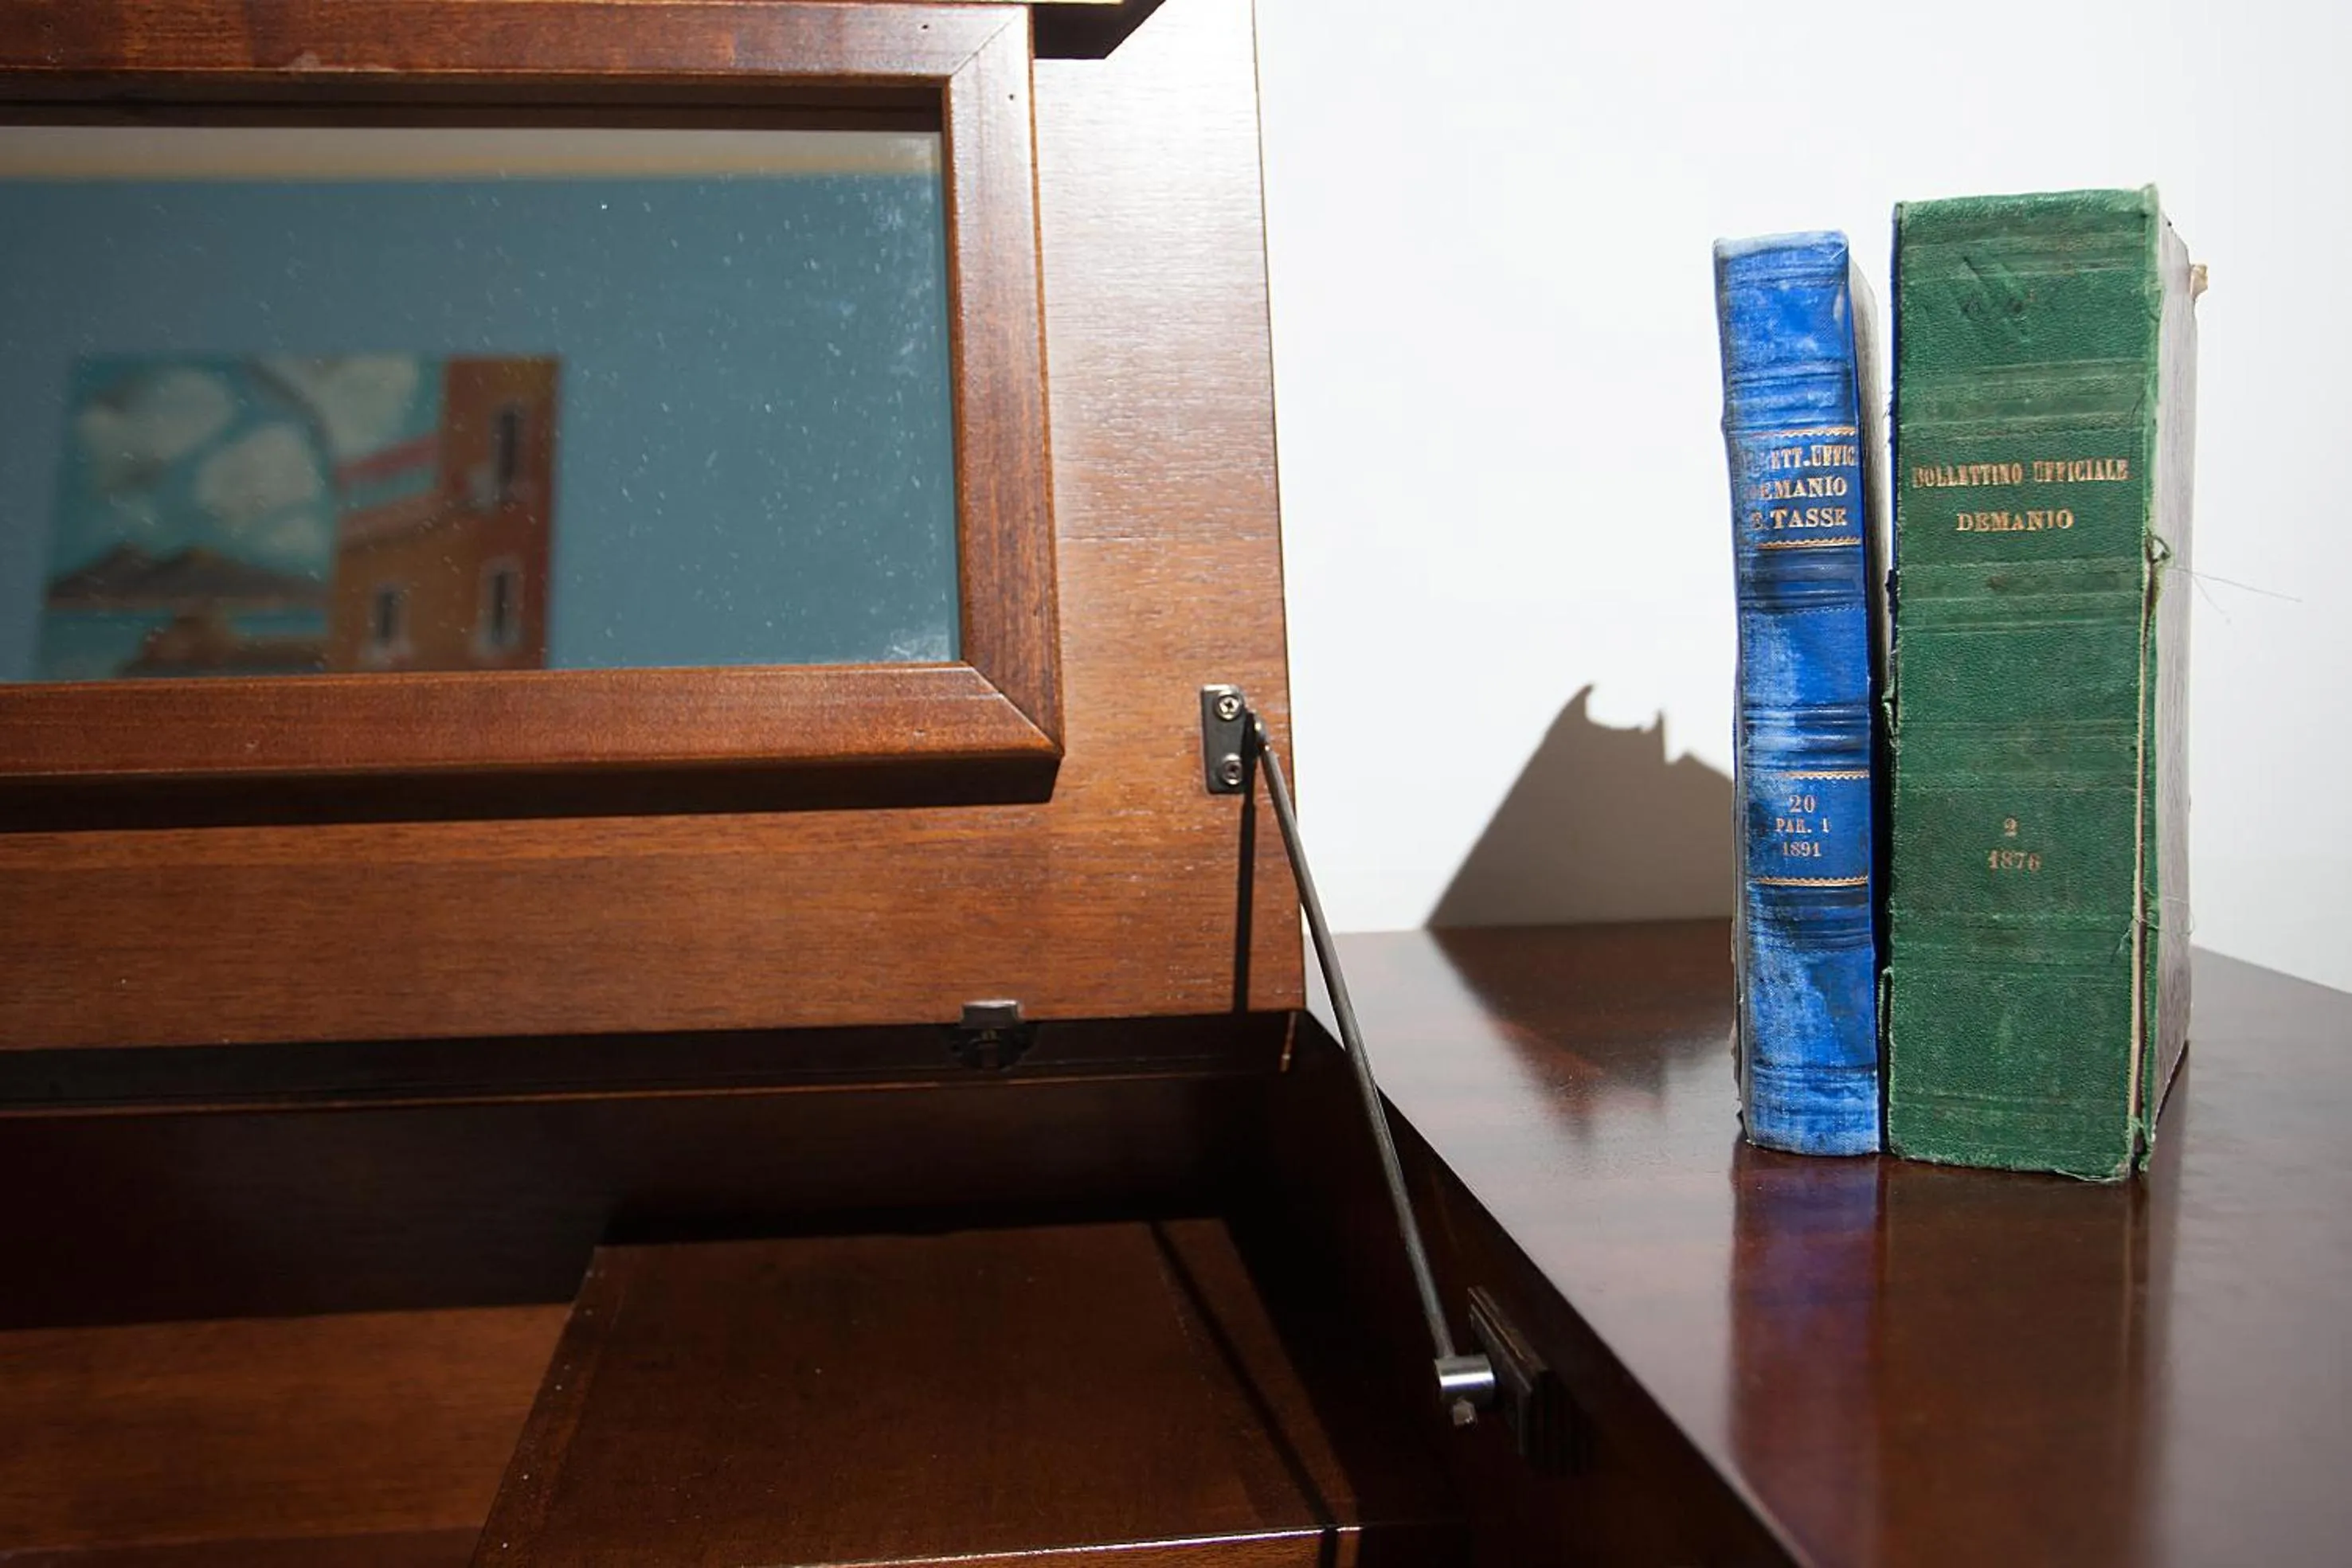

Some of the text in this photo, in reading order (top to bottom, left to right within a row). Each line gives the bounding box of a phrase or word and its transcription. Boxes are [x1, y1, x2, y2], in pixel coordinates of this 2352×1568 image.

[1912, 458, 2130, 488] BOLLETTINO UFFICIALE
[1770, 506, 1849, 530] TASSE
[1956, 509, 2075, 532] DEMANIO
[1789, 795, 1817, 814] 20
[1775, 817, 1812, 834] PAR.
[1782, 841, 1822, 858] 1891
